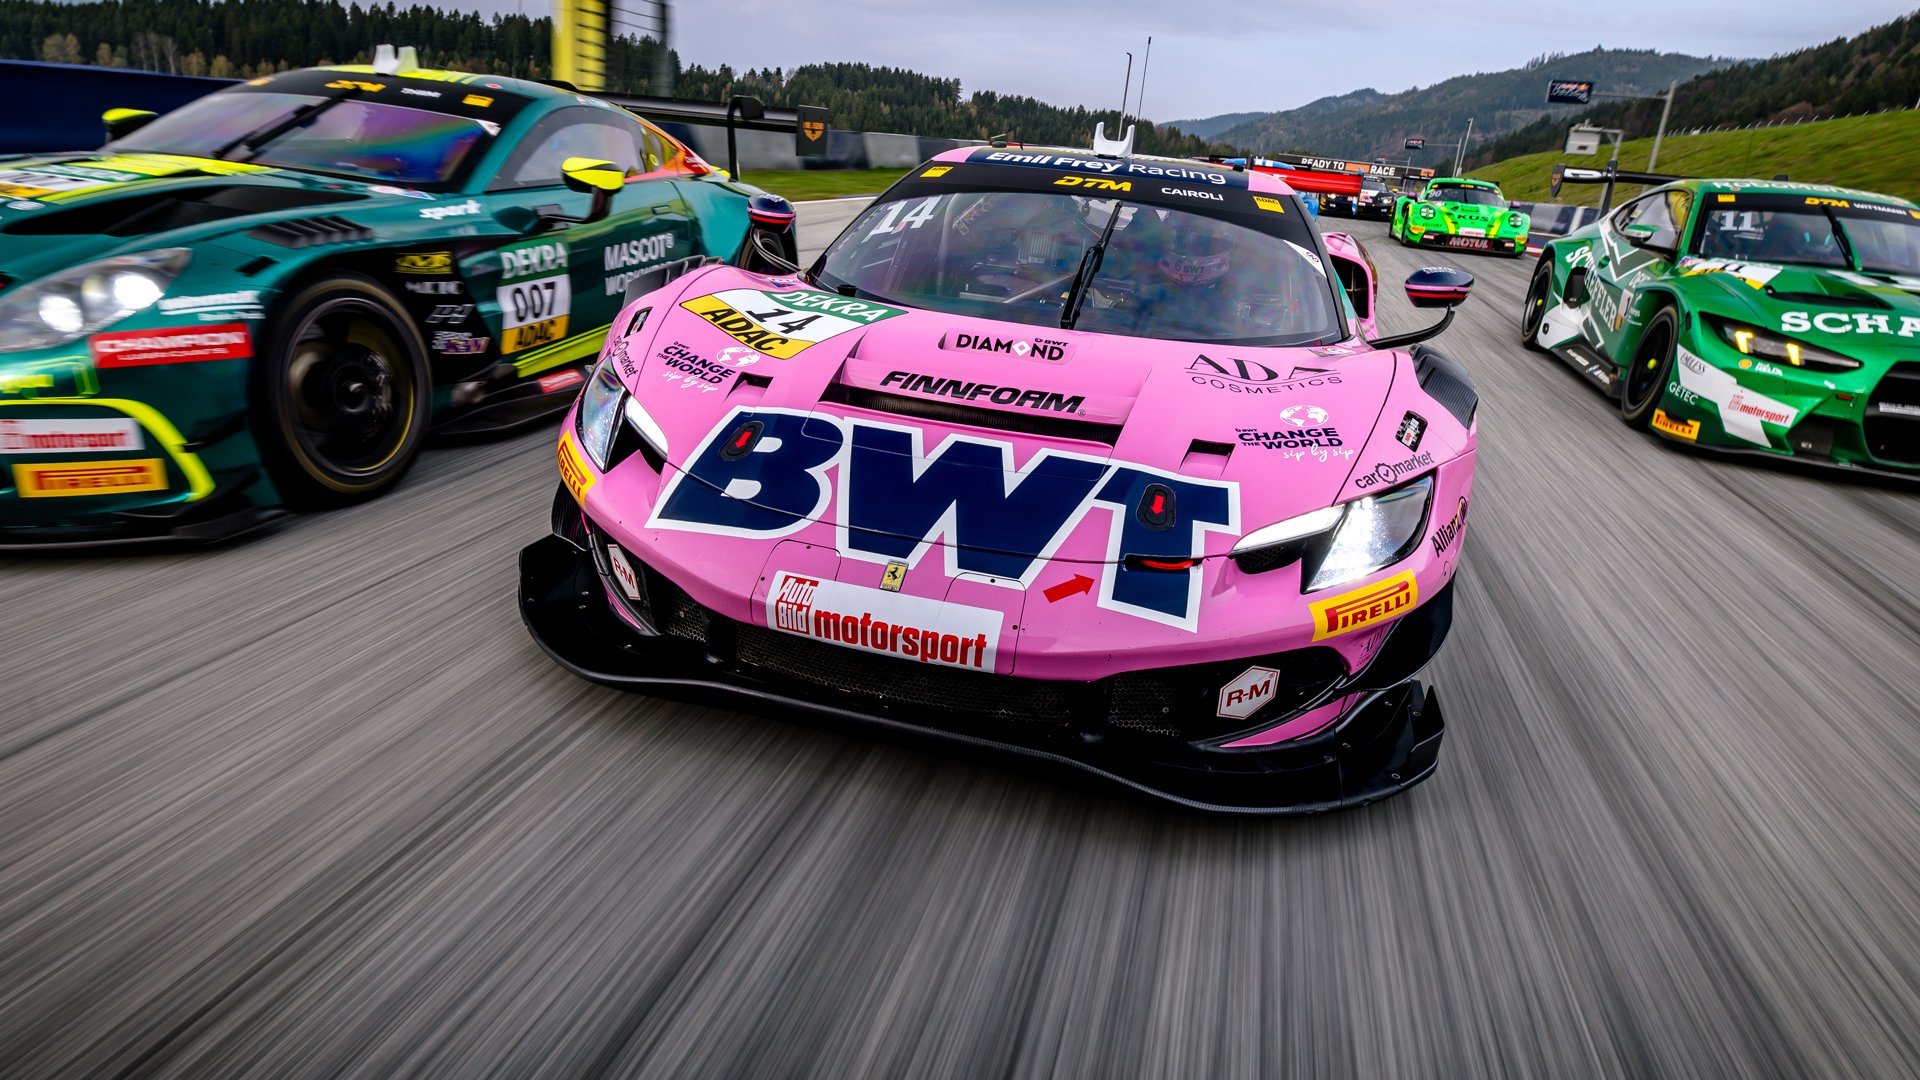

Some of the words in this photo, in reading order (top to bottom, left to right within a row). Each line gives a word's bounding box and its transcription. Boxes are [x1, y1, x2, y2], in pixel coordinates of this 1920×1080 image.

[986, 152, 1052, 164] Emil
[1053, 157, 1122, 172] Frey
[1128, 163, 1227, 185] Racing
[1301, 157, 1331, 169] READY
[1332, 160, 1345, 170] TO
[1370, 165, 1396, 176] RACE
[1053, 175, 1132, 192] DTM
[1161, 187, 1224, 201] CAIROLI
[864, 194, 943, 239] 14
[1804, 197, 1850, 209] DTM
[1720, 210, 1759, 232] 11
[1448, 236, 1490, 249] MOTUL
[511, 281, 557, 323] 007
[772, 291, 889, 322] DEKRA
[699, 306, 790, 352] ADAC
[745, 308, 824, 335] 14
[656, 353, 671, 361] THE
[664, 357, 724, 384] WORLD
[663, 345, 737, 378] CHANGE
[1184, 354, 1337, 382] ADA
[662, 370, 683, 382] sip
[697, 382, 719, 393] sip
[1191, 376, 1343, 395] COSMETICS
[1669, 382, 1699, 406] GETEC
[1655, 412, 1694, 435] PIRELLI
[1740, 405, 1790, 425] motorsport
[1238, 427, 1340, 442] CHANGE
[1261, 438, 1344, 450] WORLD
[1283, 450, 1306, 462] sip
[1310, 443, 1328, 462] by
[1332, 446, 1355, 460] sip
[557, 440, 588, 498] PIRELLI
[647, 408, 1238, 629] BWT
[612, 555, 635, 589] R-M
[778, 577, 817, 606] Auto
[1325, 580, 1411, 634] PIRELLI
[778, 602, 810, 632] Bild
[814, 610, 988, 668] motorsport
[1226, 679, 1271, 707] R-M
